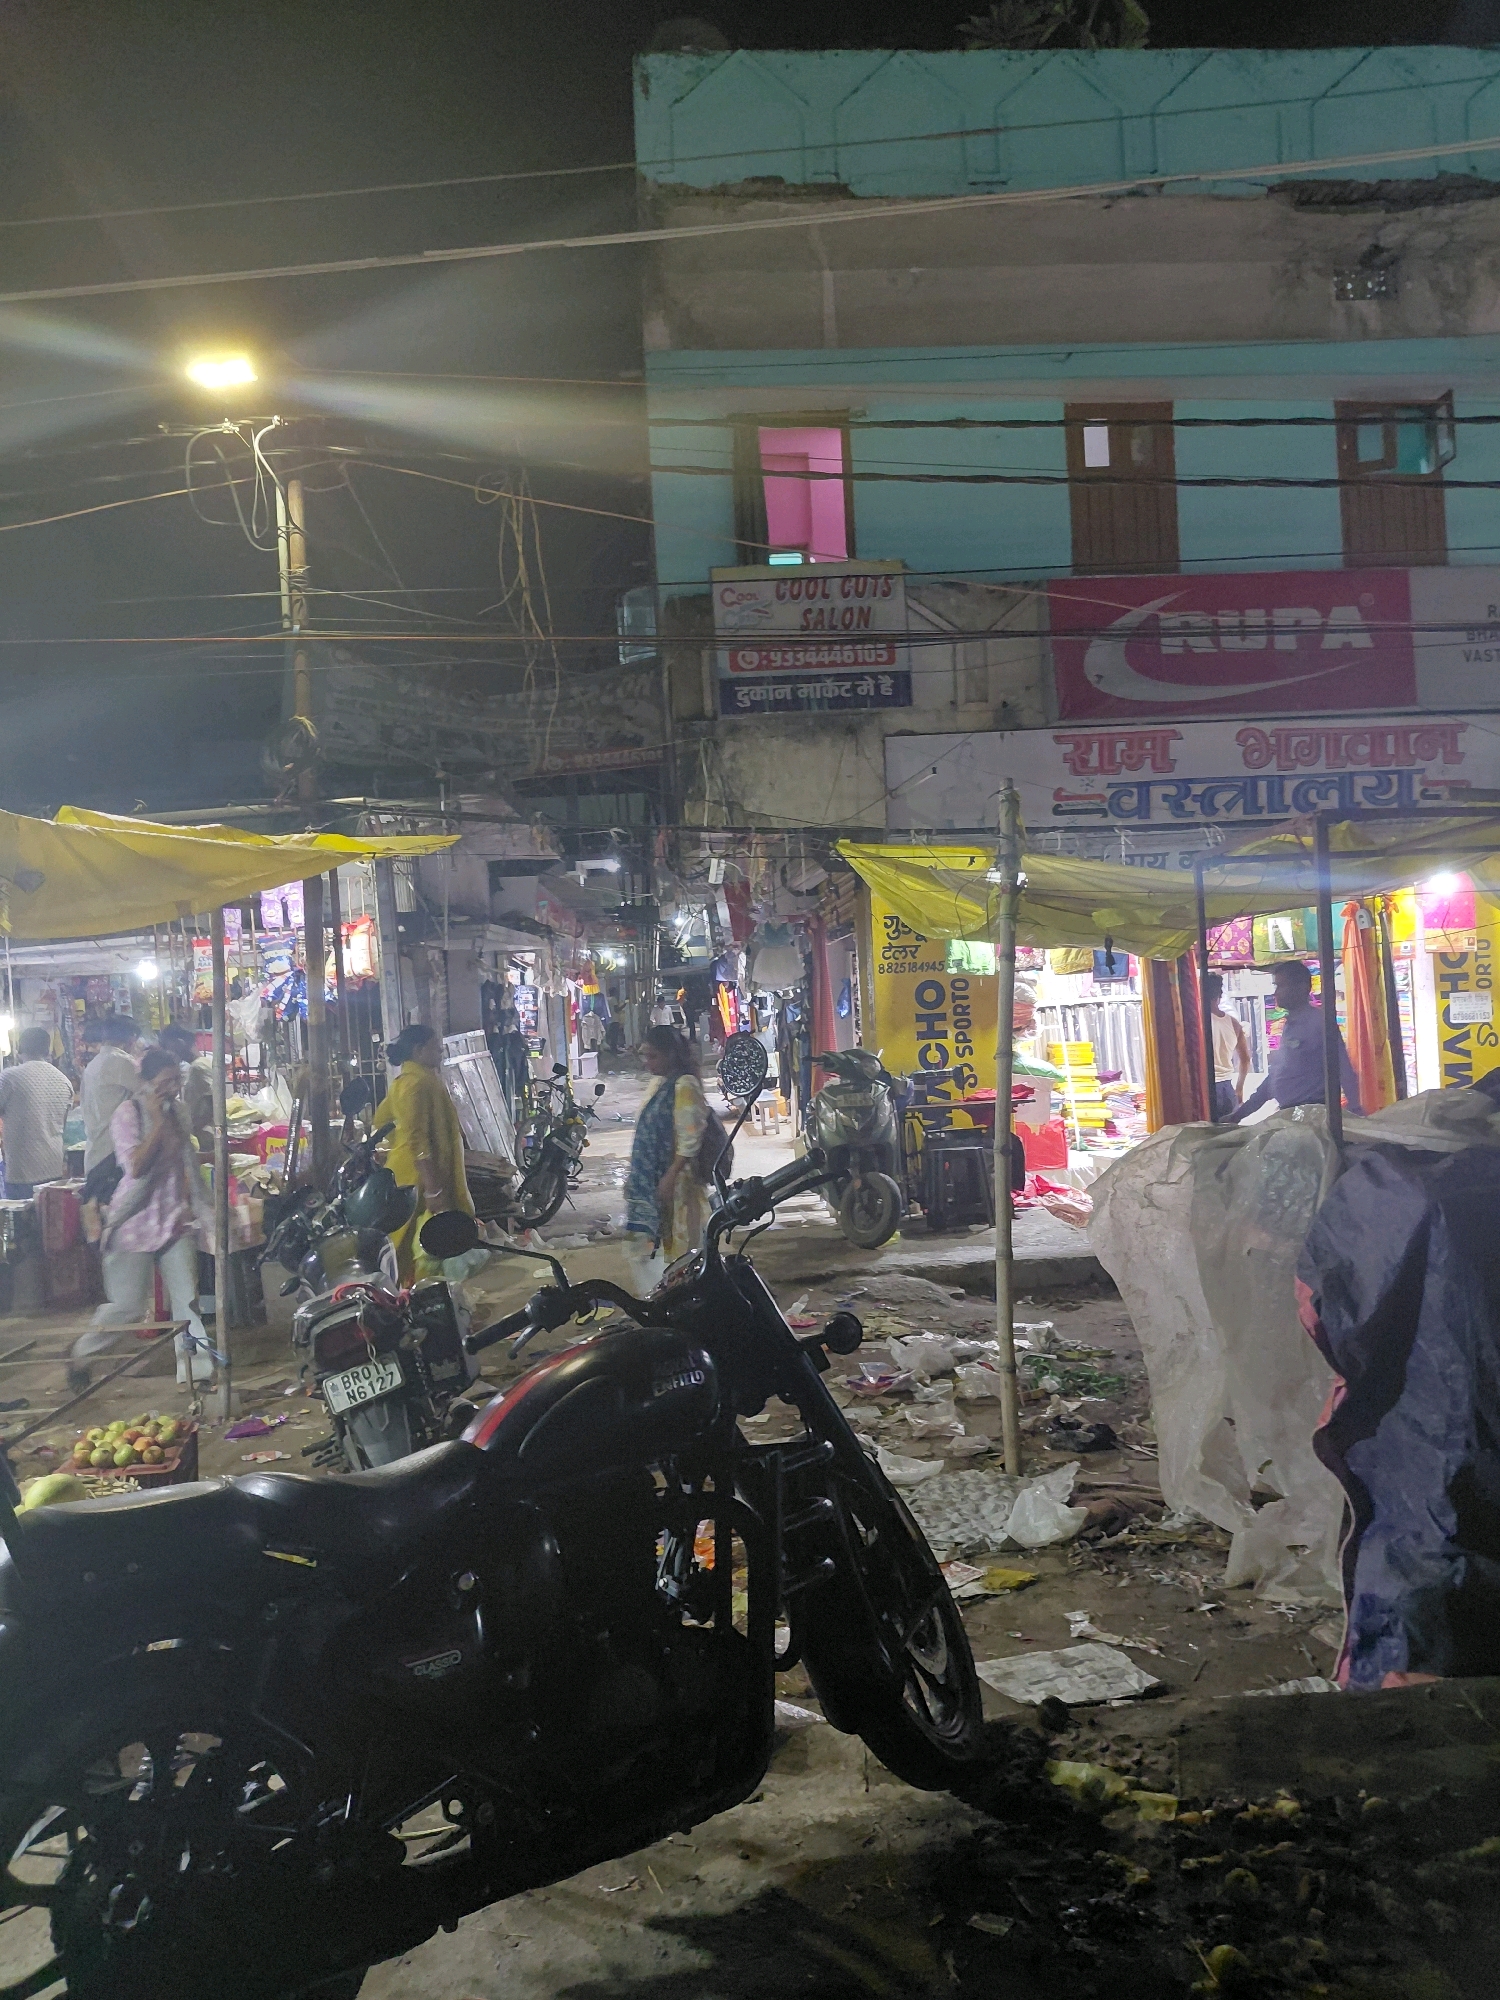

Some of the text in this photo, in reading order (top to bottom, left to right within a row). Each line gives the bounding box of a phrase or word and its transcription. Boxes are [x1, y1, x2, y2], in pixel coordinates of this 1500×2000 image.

[775, 575, 894, 601] COOL CUTS
[801, 606, 872, 630] SALON
[1158, 606, 1375, 654] RUPA
[735, 683, 792, 708] दुकान
[878, 674, 894, 697] है
[1053, 722, 1470, 777] राम भगवान
[1107, 767, 1427, 820] वस्त्रालय
[878, 960, 946, 975] 8825184945
[882, 941, 921, 961] टेलर
[949, 978, 974, 1058] SPORTO
[346, 1371, 394, 1405] N6127
